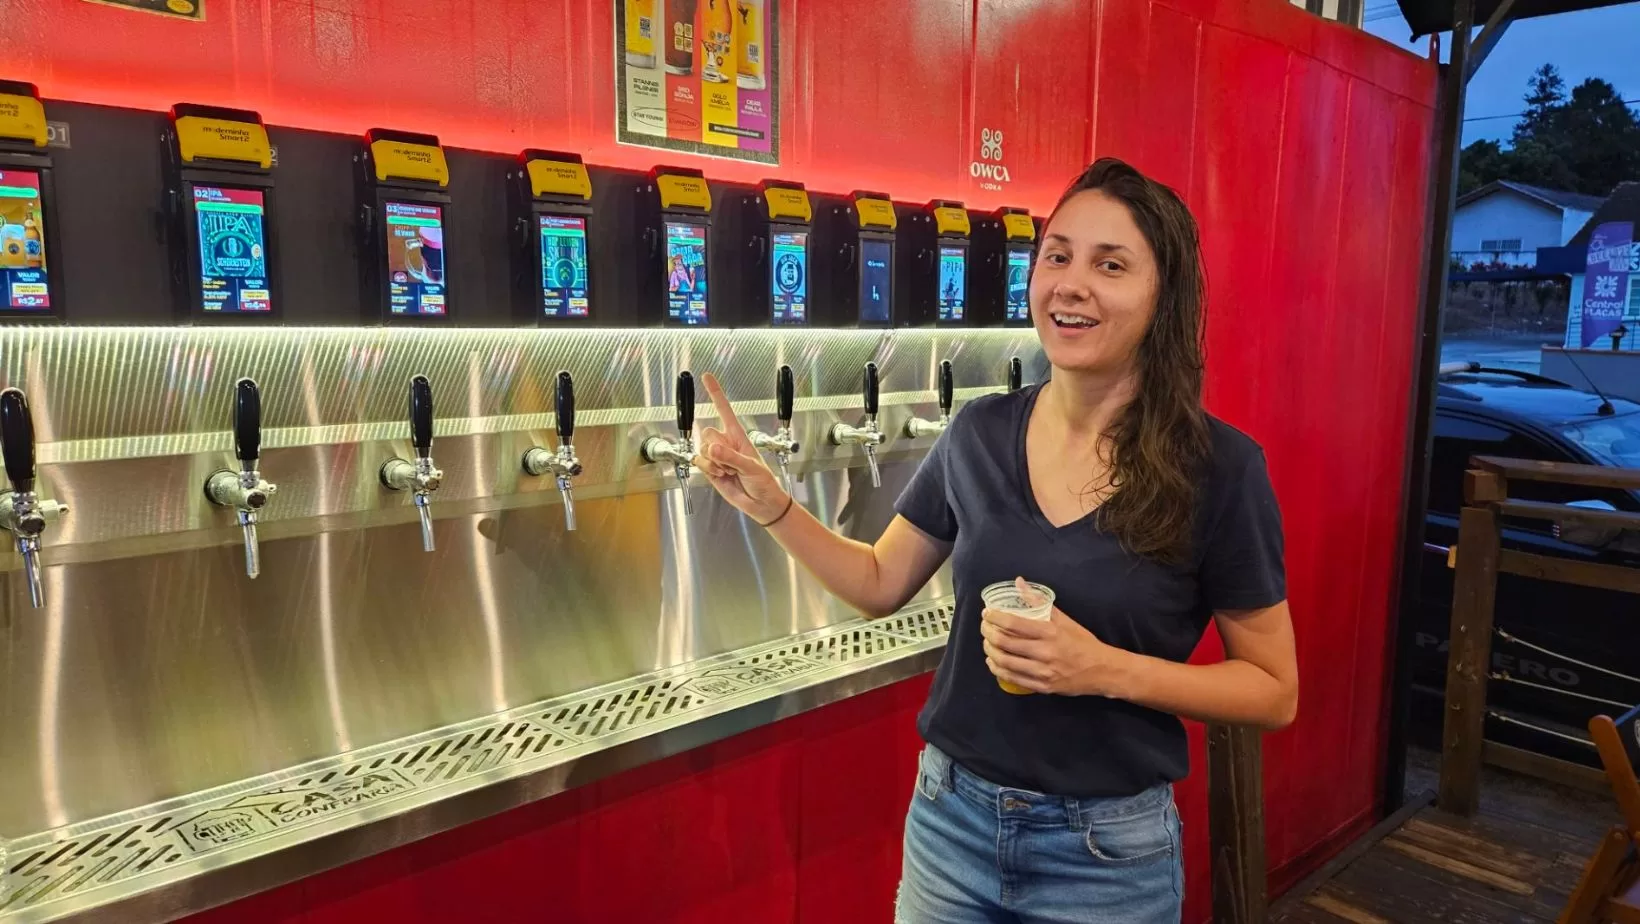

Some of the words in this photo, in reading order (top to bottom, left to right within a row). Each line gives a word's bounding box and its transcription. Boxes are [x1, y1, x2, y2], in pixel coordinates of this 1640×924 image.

[47, 126, 66, 142] 01
[970, 161, 1011, 182] OWCA
[194, 189, 209, 198] 02
[980, 182, 1002, 191] VODKA
[1584, 298, 1624, 309] Central
[1415, 631, 1581, 686] PERO
[737, 659, 805, 681] CASA
[270, 774, 394, 815] CASA
[280, 784, 405, 823] CONFRARIA
